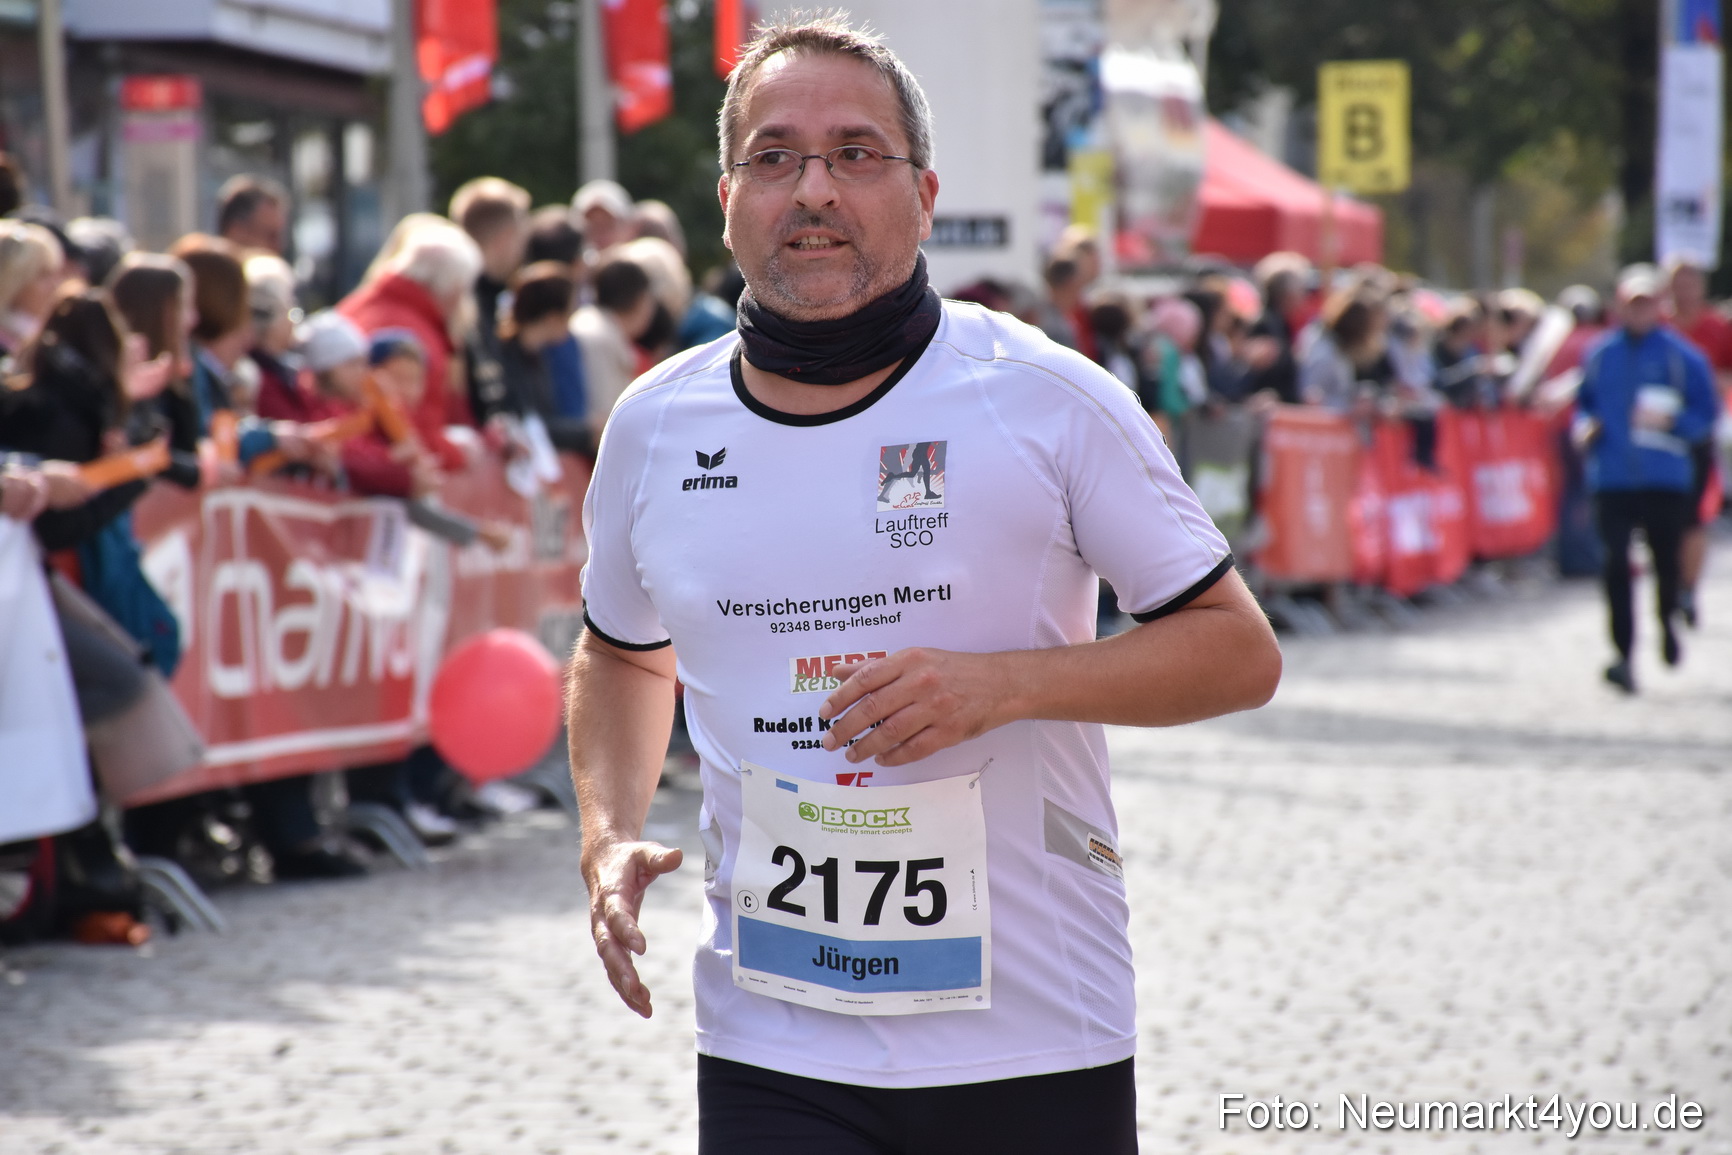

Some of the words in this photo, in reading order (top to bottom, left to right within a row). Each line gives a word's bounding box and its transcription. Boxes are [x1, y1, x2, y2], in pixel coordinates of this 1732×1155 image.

[1344, 104, 1384, 161] B
[682, 474, 738, 491] erima
[875, 512, 949, 533] Lauftreff
[890, 530, 934, 549] SCO
[717, 592, 887, 616] Versicherungen
[893, 584, 951, 604] Mertl
[770, 620, 811, 634] 92348
[814, 612, 902, 632] Berg-Irleshof
[792, 671, 845, 693] Reis
[753, 716, 813, 733] Rudolf
[821, 806, 912, 828] BOCK
[821, 825, 848, 834] inspired
[882, 827, 913, 835] concepts
[767, 845, 948, 927] 2175
[744, 895, 752, 908] C
[812, 945, 900, 981] Jürgen
